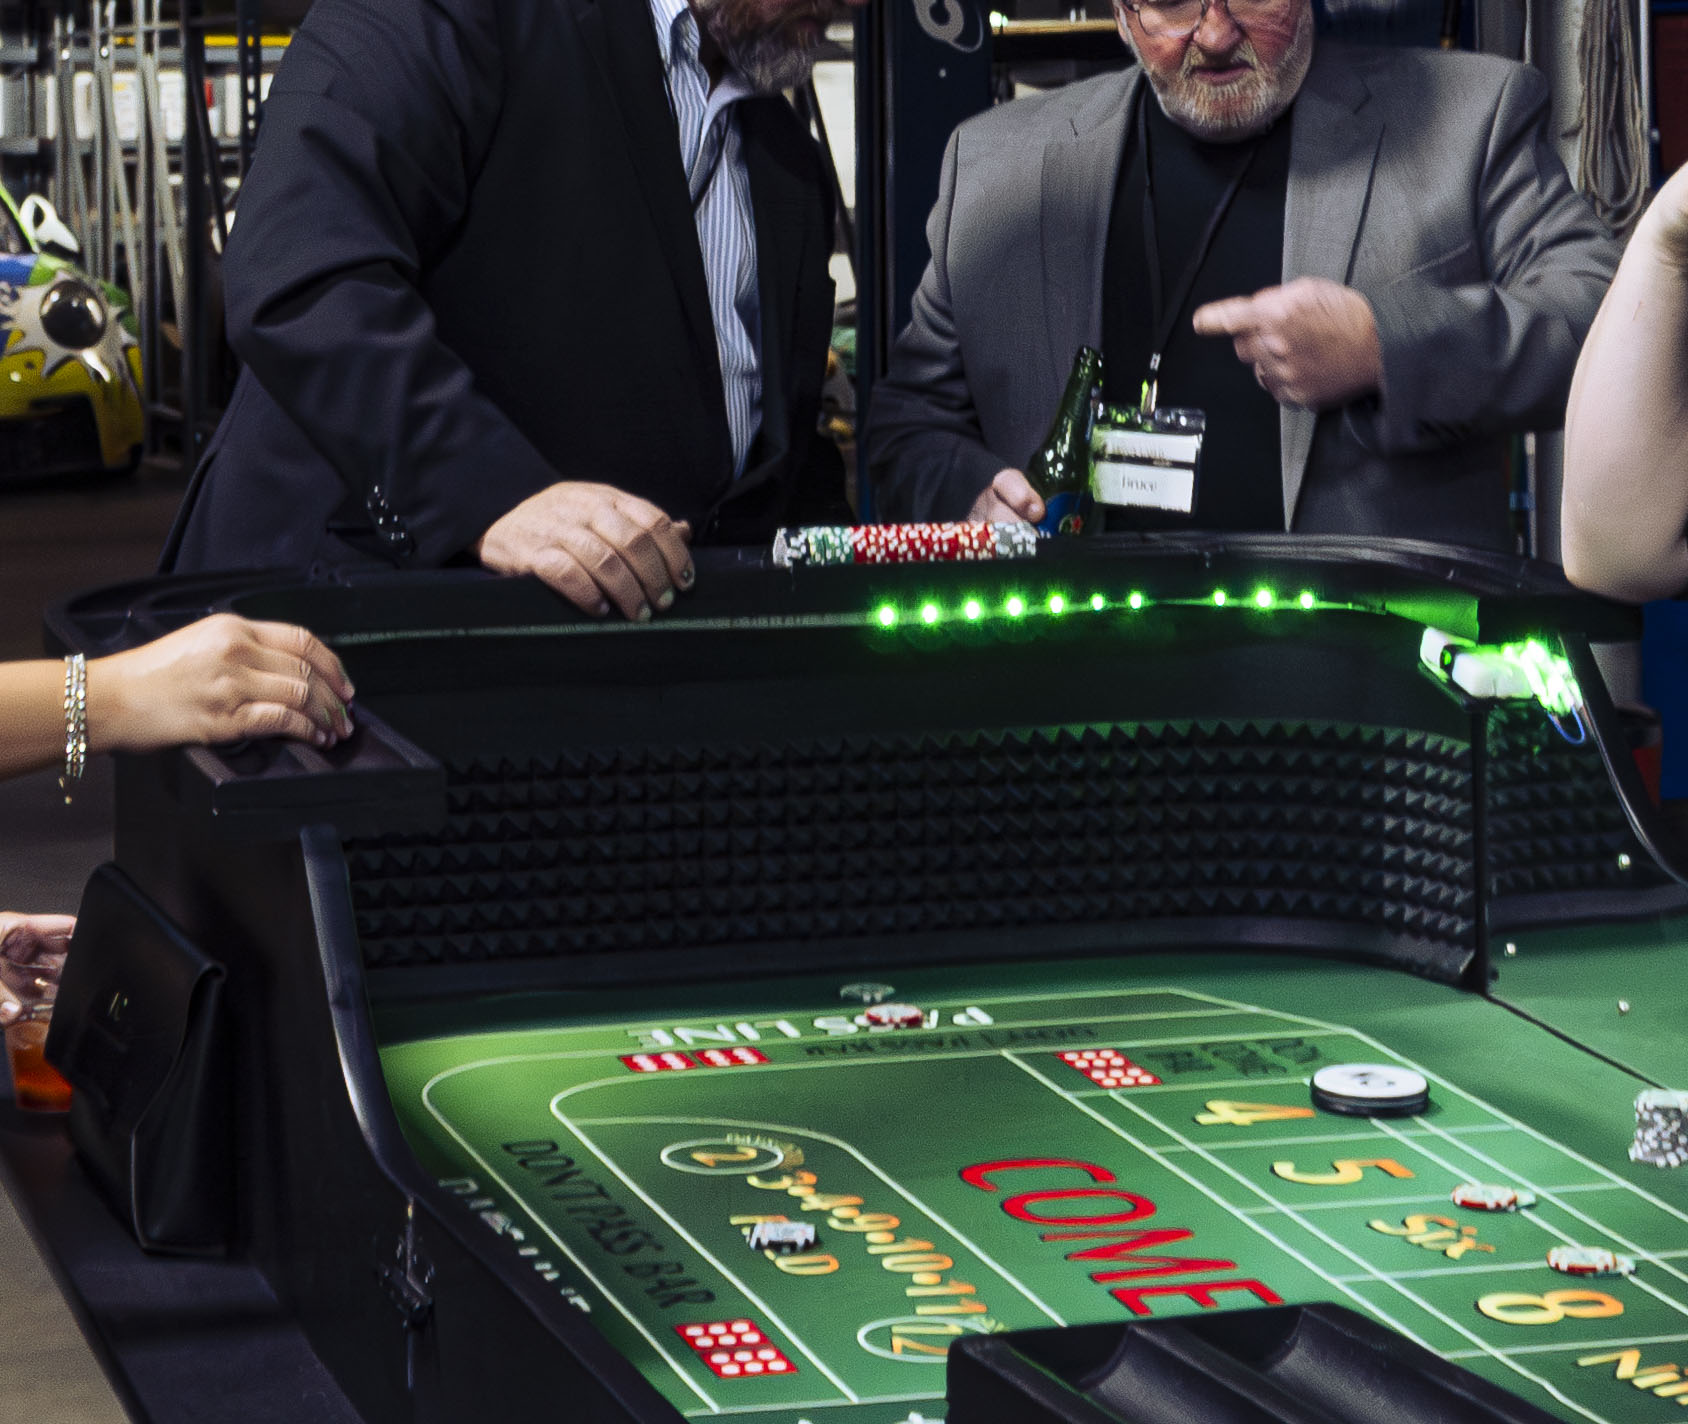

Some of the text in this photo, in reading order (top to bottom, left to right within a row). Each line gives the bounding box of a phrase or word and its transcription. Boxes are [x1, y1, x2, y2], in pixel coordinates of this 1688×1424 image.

[1193, 1099, 1314, 1127] 4
[1271, 1159, 1415, 1186] 5
[960, 1157, 1286, 1316] COME
[1477, 1288, 1624, 1325] 8
